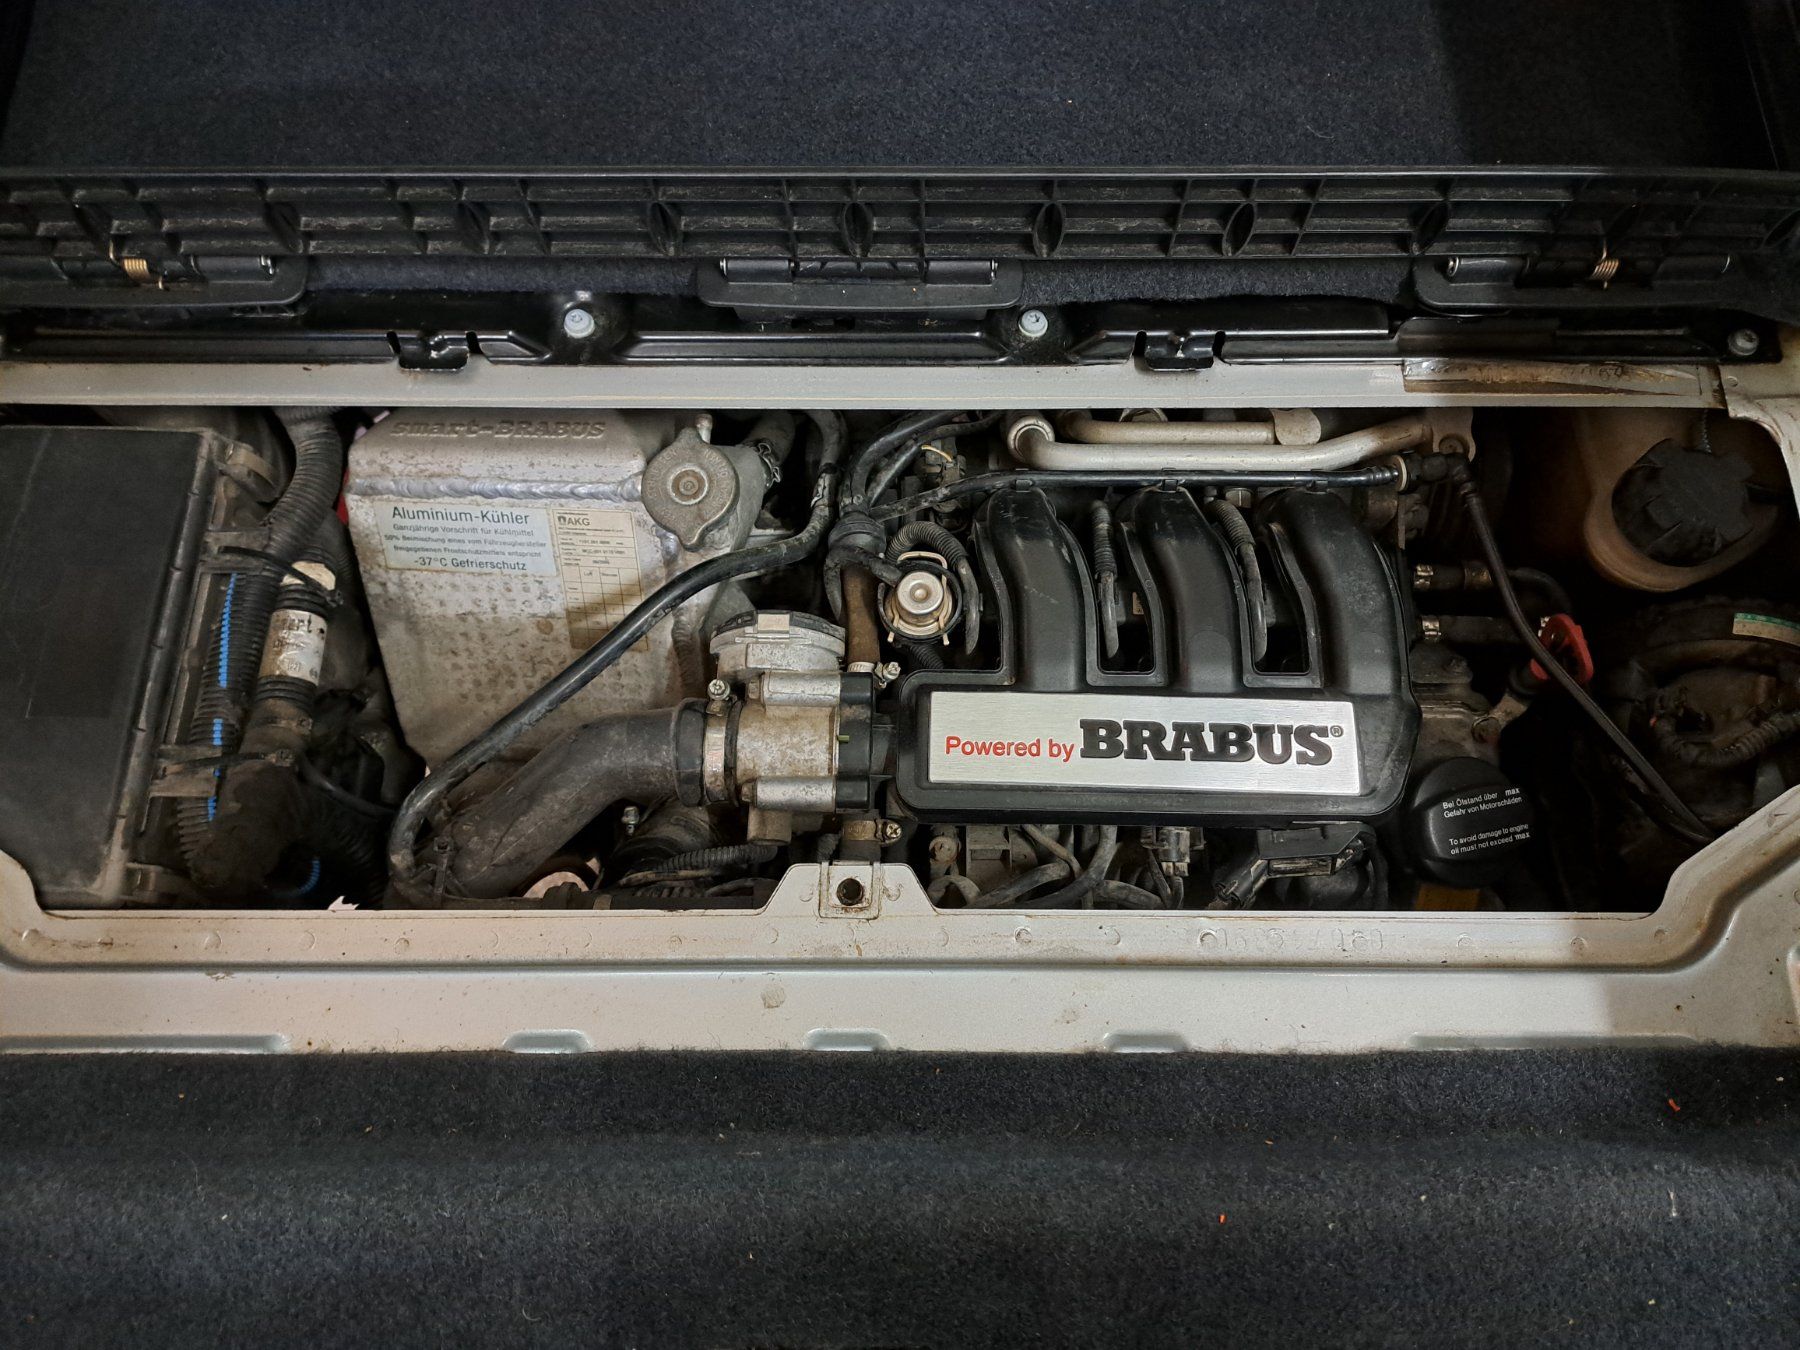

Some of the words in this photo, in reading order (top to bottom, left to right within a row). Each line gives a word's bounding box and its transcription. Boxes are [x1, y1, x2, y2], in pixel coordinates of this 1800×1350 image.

[390, 420, 605, 439] smart-BRABUS
[392, 506, 530, 524] Aluminium-Kühler
[567, 517, 590, 526] AKG
[393, 523, 439, 533] Ganzjährige
[441, 526, 479, 535] Vorschrift
[494, 529, 534, 537] Kühlmittel
[451, 558, 527, 571] Gefrierschutz
[945, 735, 1041, 758] Powered
[1047, 738, 1075, 763] by
[1442, 801, 1454, 809] Bei
[1456, 795, 1482, 806] Ölstand
[1484, 792, 1498, 800] über
[1505, 788, 1520, 796] max
[1444, 808, 1466, 818] Gefahr
[1480, 797, 1522, 810] Motorschäden
[1459, 834, 1477, 843] avoid
[1477, 829, 1502, 839] damage
[1509, 824, 1529, 833] engine
[1460, 844, 1477, 852] must
[1490, 836, 1513, 846] exceed
[1515, 832, 1530, 840] max
